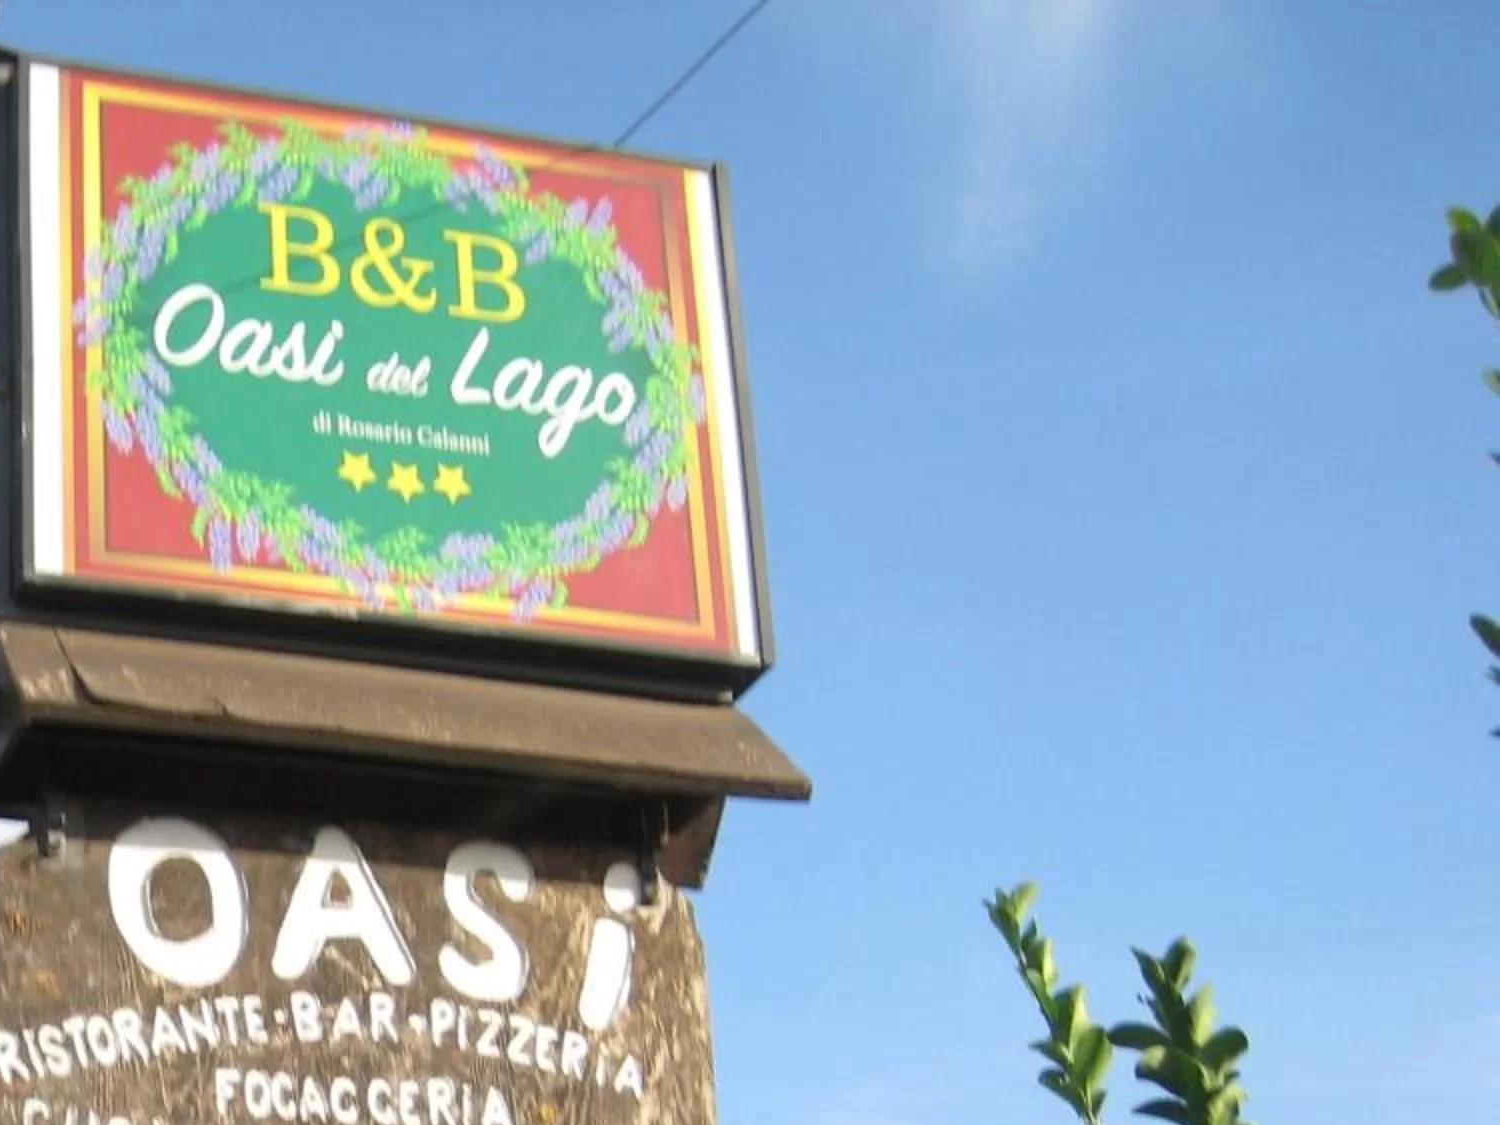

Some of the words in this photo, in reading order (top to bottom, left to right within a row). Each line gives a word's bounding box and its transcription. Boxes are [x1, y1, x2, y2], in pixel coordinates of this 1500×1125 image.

[258, 202, 527, 323] B&B
[152, 284, 345, 386] Oasi
[366, 350, 431, 398] del
[450, 326, 637, 459] Lago
[312, 409, 331, 435] di
